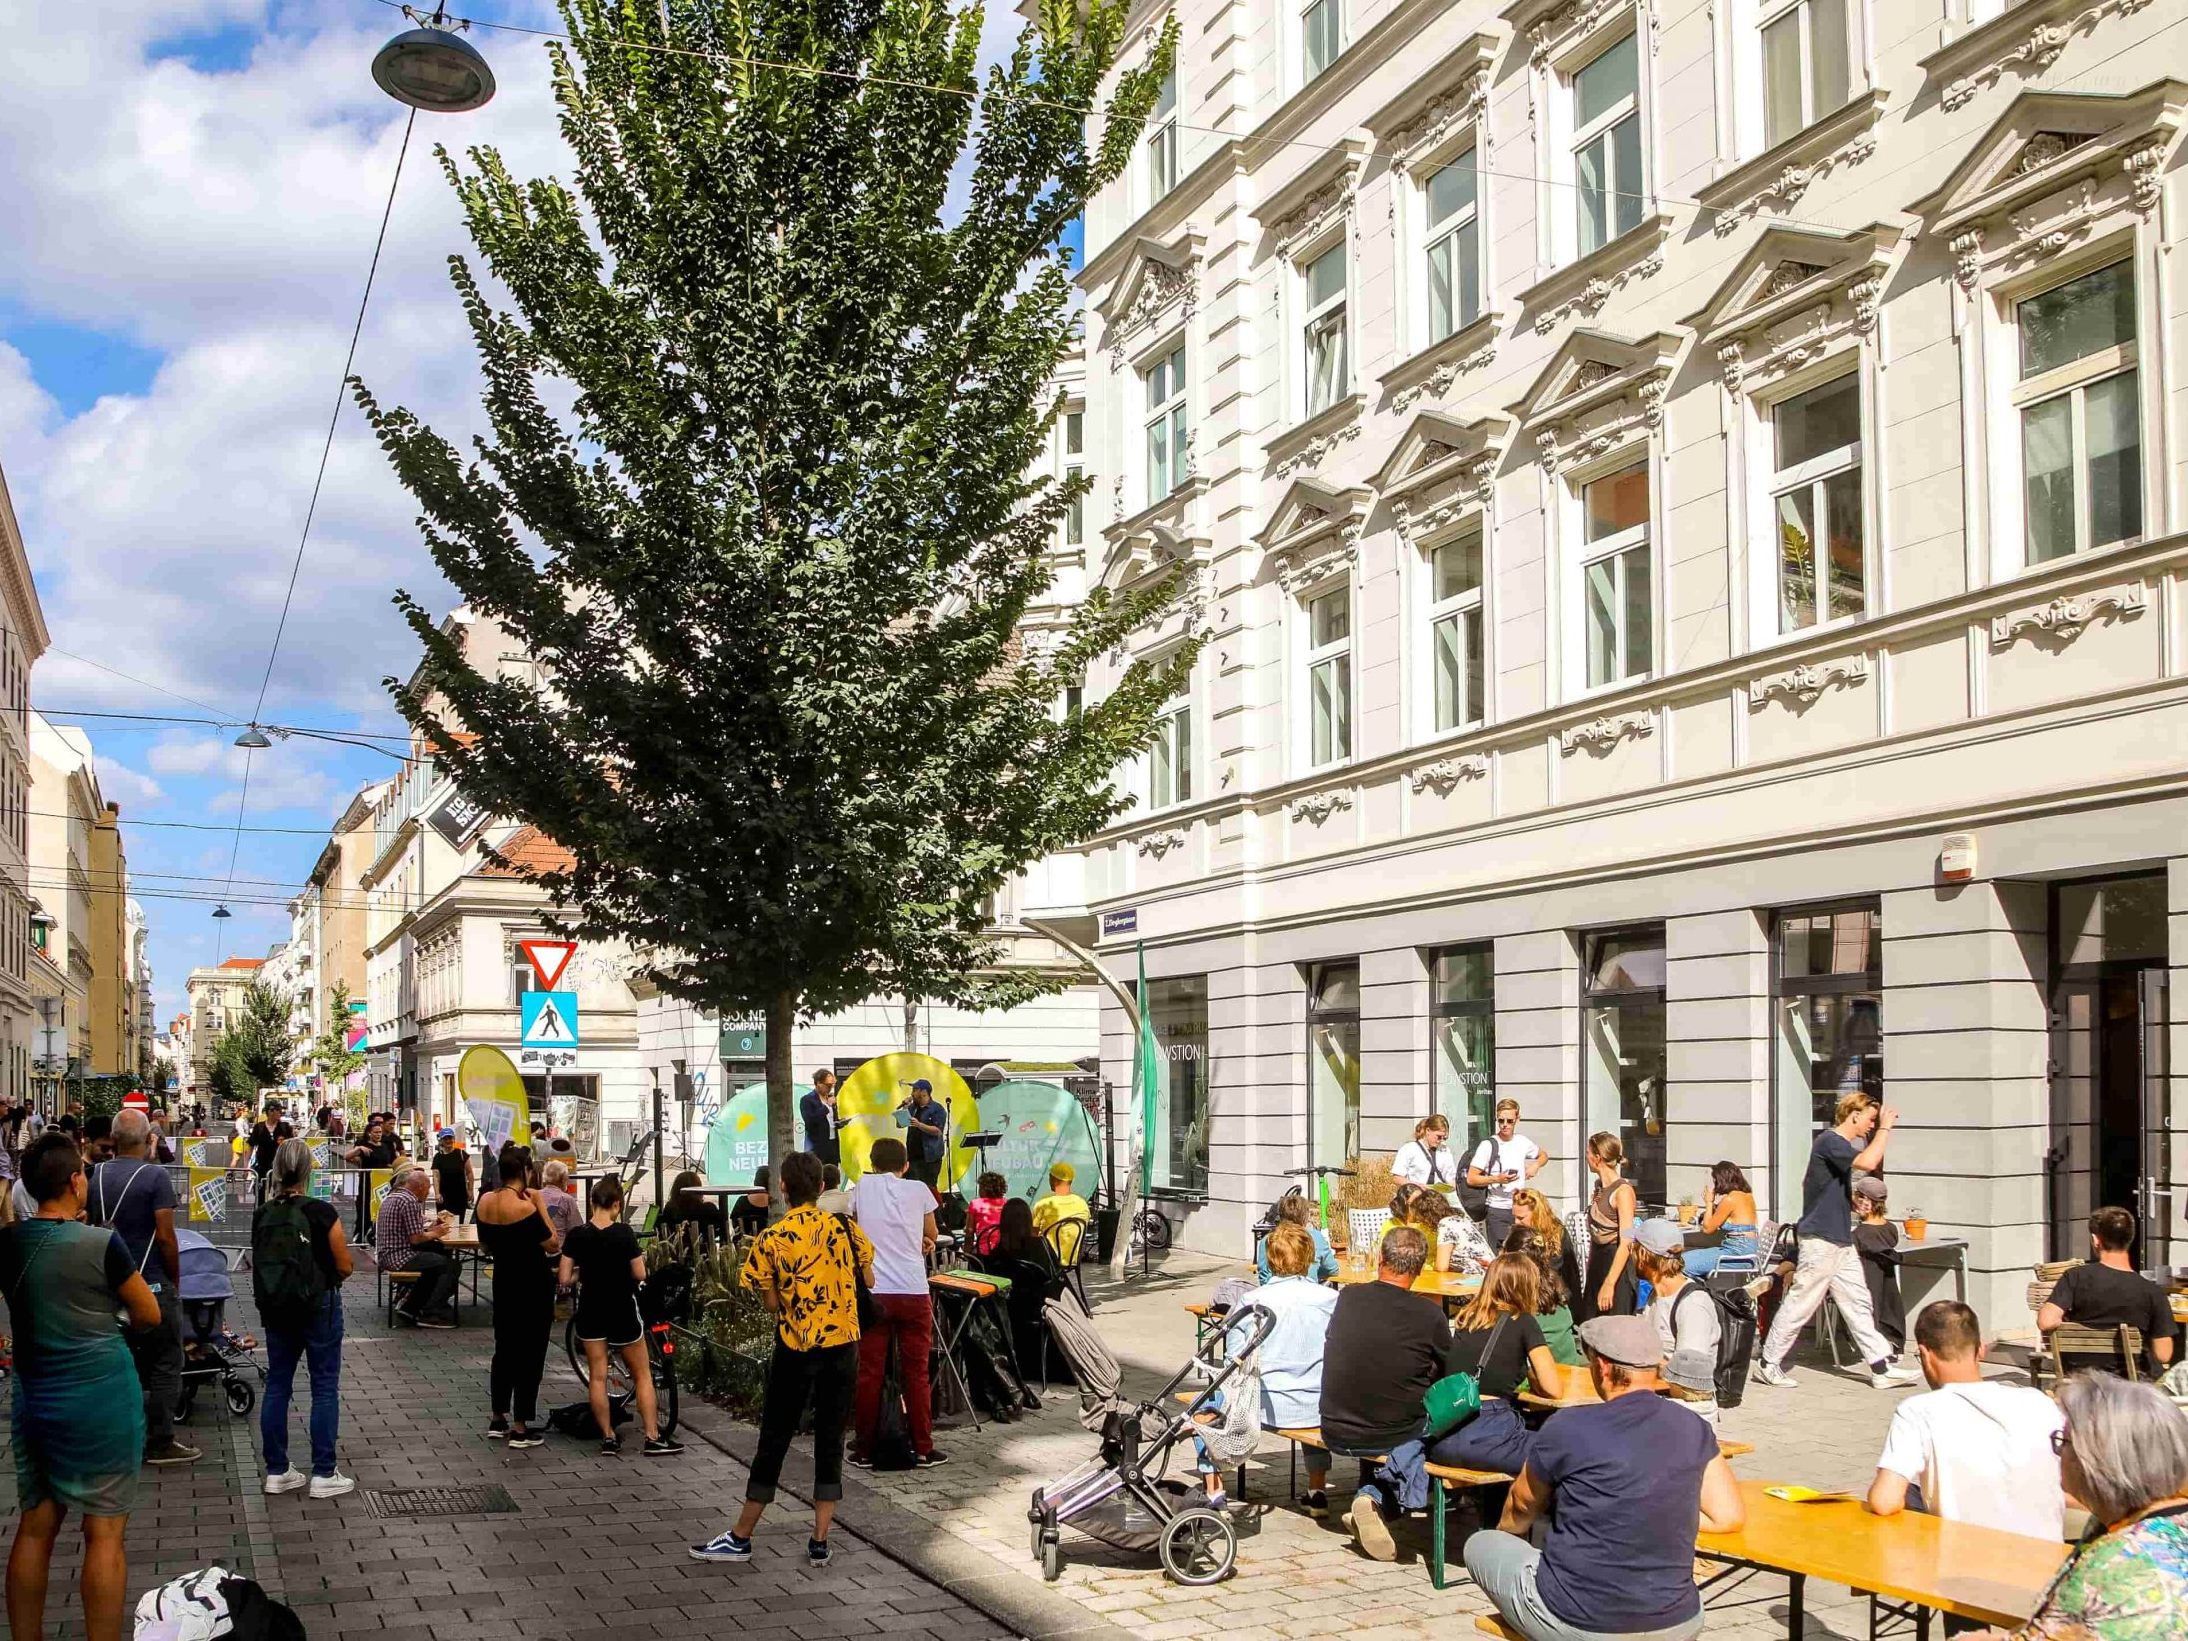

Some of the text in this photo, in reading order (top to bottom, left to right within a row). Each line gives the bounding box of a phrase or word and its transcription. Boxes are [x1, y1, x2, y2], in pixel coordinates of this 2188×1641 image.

[722, 1022, 766, 1031] COMPANY
[1156, 1044, 1201, 1061] WSTION
[735, 1141, 768, 1154] BEZ
